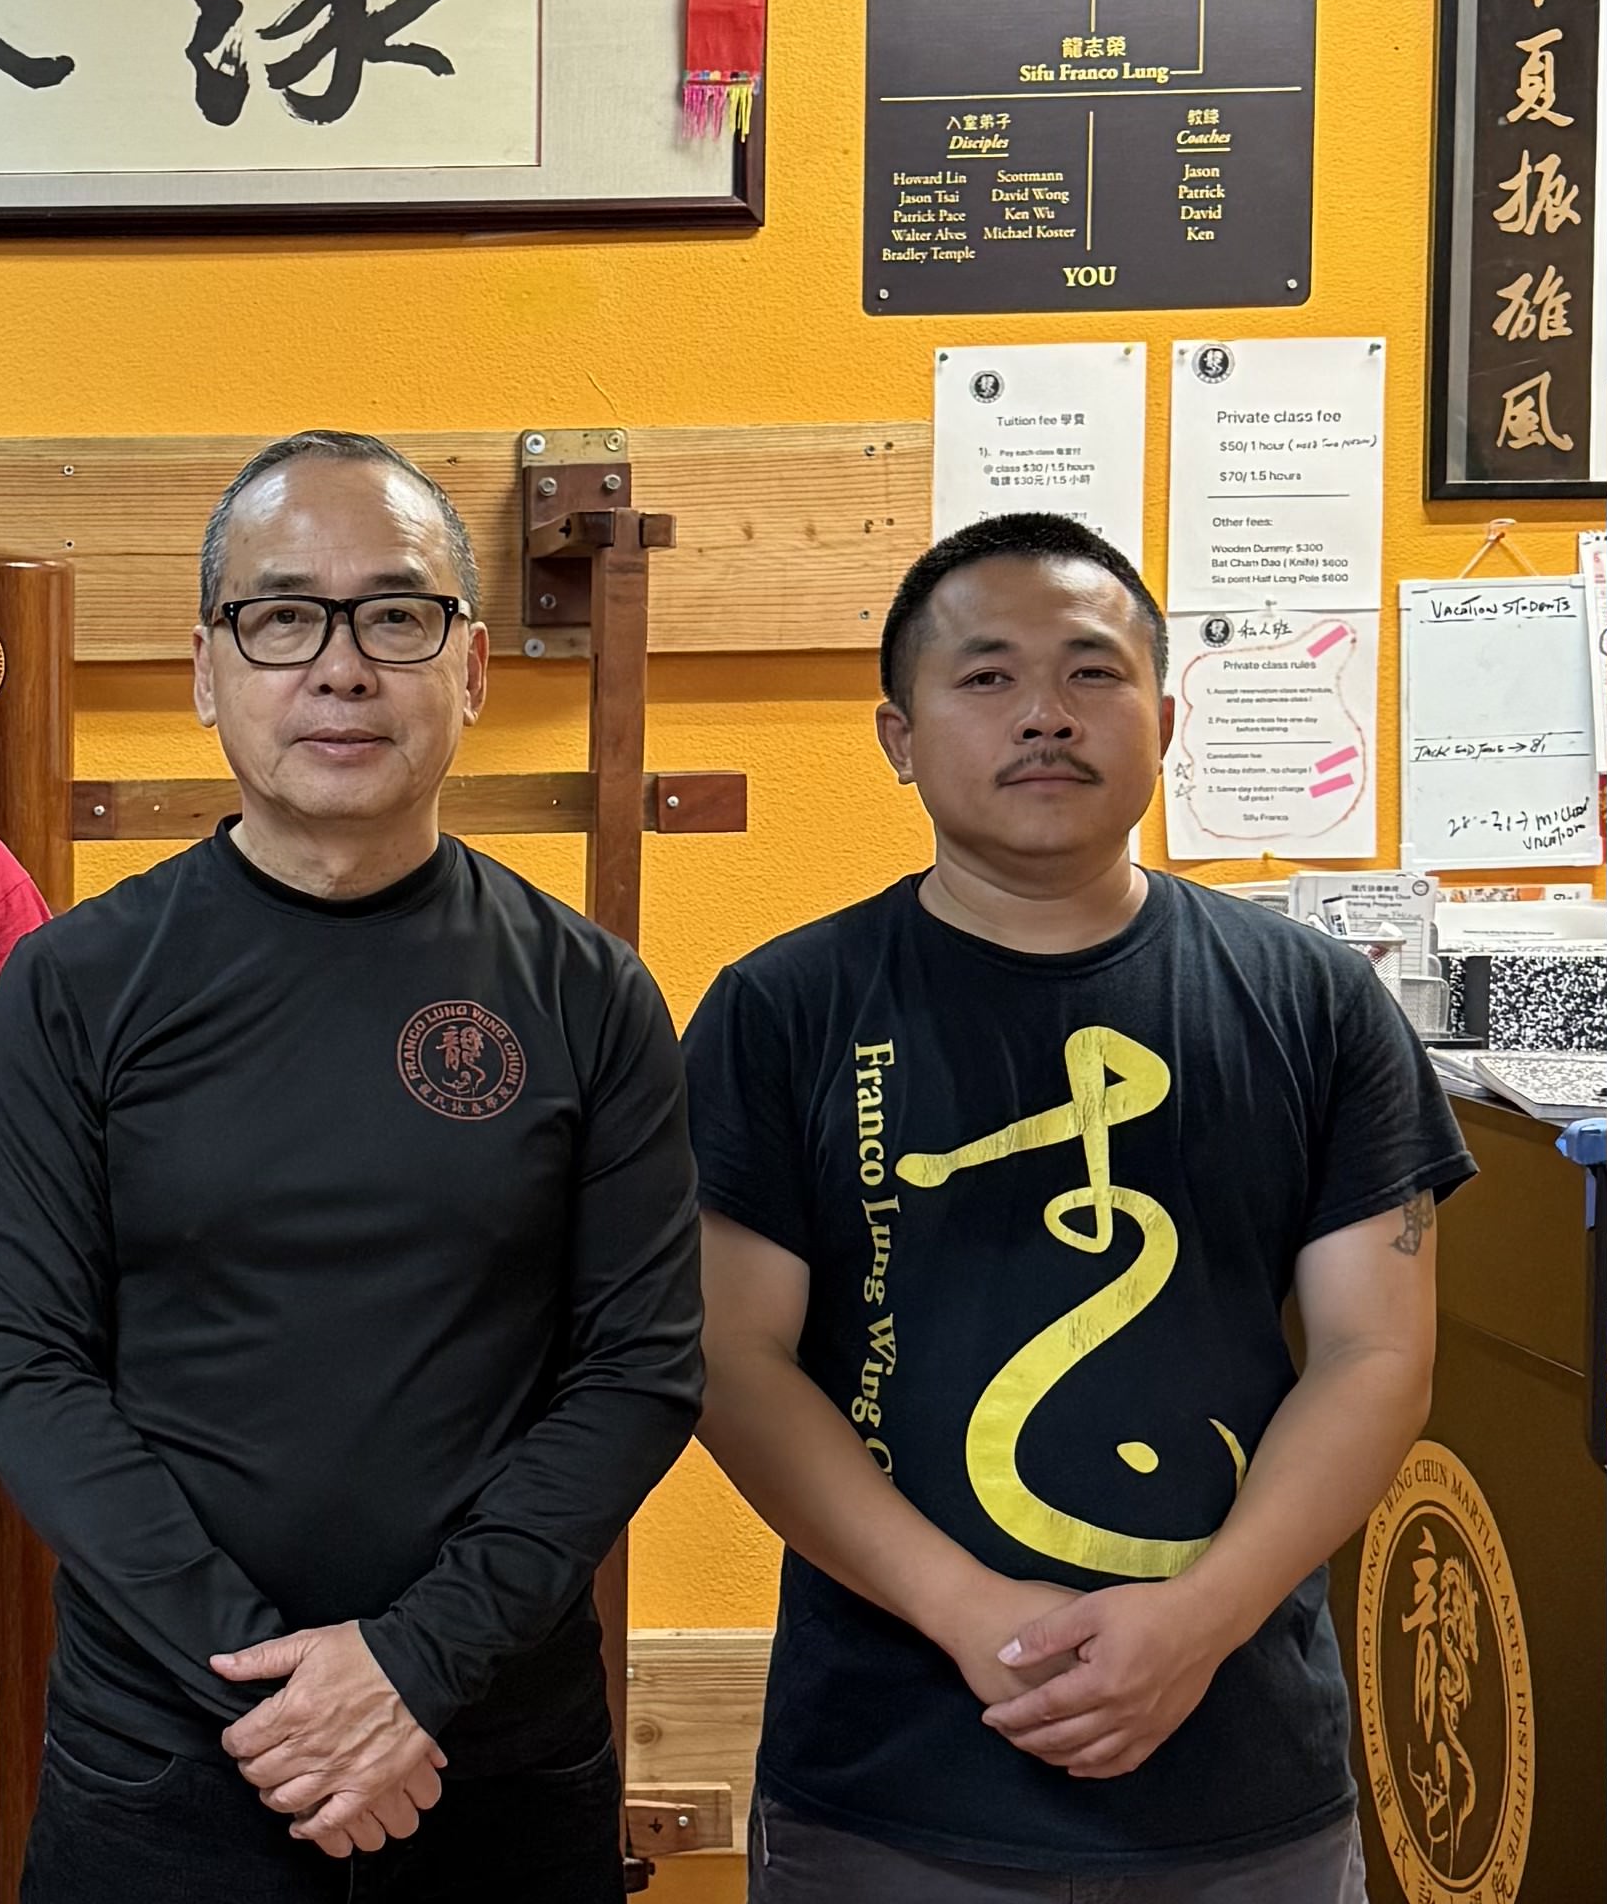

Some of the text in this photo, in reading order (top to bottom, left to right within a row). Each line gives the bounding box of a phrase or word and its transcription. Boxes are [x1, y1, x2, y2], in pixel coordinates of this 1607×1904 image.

[1019, 63, 1170, 84] Sifu Franco Lung
[949, 134, 1009, 153] Disciples
[1176, 129, 1231, 144] Coaches
[894, 171, 967, 185] Howard Lin
[997, 170, 1064, 183] Scottmann
[1182, 164, 1220, 181] Jason
[898, 190, 960, 206] Jason Tsai
[991, 188, 1070, 204] David Wong
[1178, 184, 1225, 200] Patrick
[893, 209, 966, 223] Patrick Pace
[1004, 207, 1055, 220] Ken Wu
[1180, 204, 1222, 220] David
[891, 227, 967, 241] Walter Alves
[983, 225, 1076, 240] Michael Koster
[1186, 226, 1215, 240] Ken
[882, 246, 976, 263] Bradley Temple
[1062, 265, 1117, 286] YOU
[996, 415, 1036, 427] Tuition
[1039, 414, 1057, 426] fee
[1216, 411, 1270, 424] Private
[1273, 410, 1313, 423] class
[1258, 440, 1285, 450] hour
[996, 464, 1020, 473] class
[1067, 462, 1095, 472] hours
[1269, 470, 1301, 481] hours
[1212, 517, 1243, 527] Other
[1211, 544, 1251, 554] Wooden
[1273, 574, 1296, 585] Long
[1223, 660, 1260, 670] Private
[1262, 660, 1288, 670] class
[404, 1005, 521, 1085] FRANCO LUNG WING CHUN
[854, 1039, 895, 1187] Franco
[861, 1195, 900, 1306] Lung
[851, 1313, 896, 1429] Wing
[1414, 1458, 1448, 1488] CHUN
[1450, 1472, 1502, 1584] MARTIAL
[1501, 1594, 1523, 1675] ARTS
[1505, 1692, 1529, 1865] INSTITUTE
